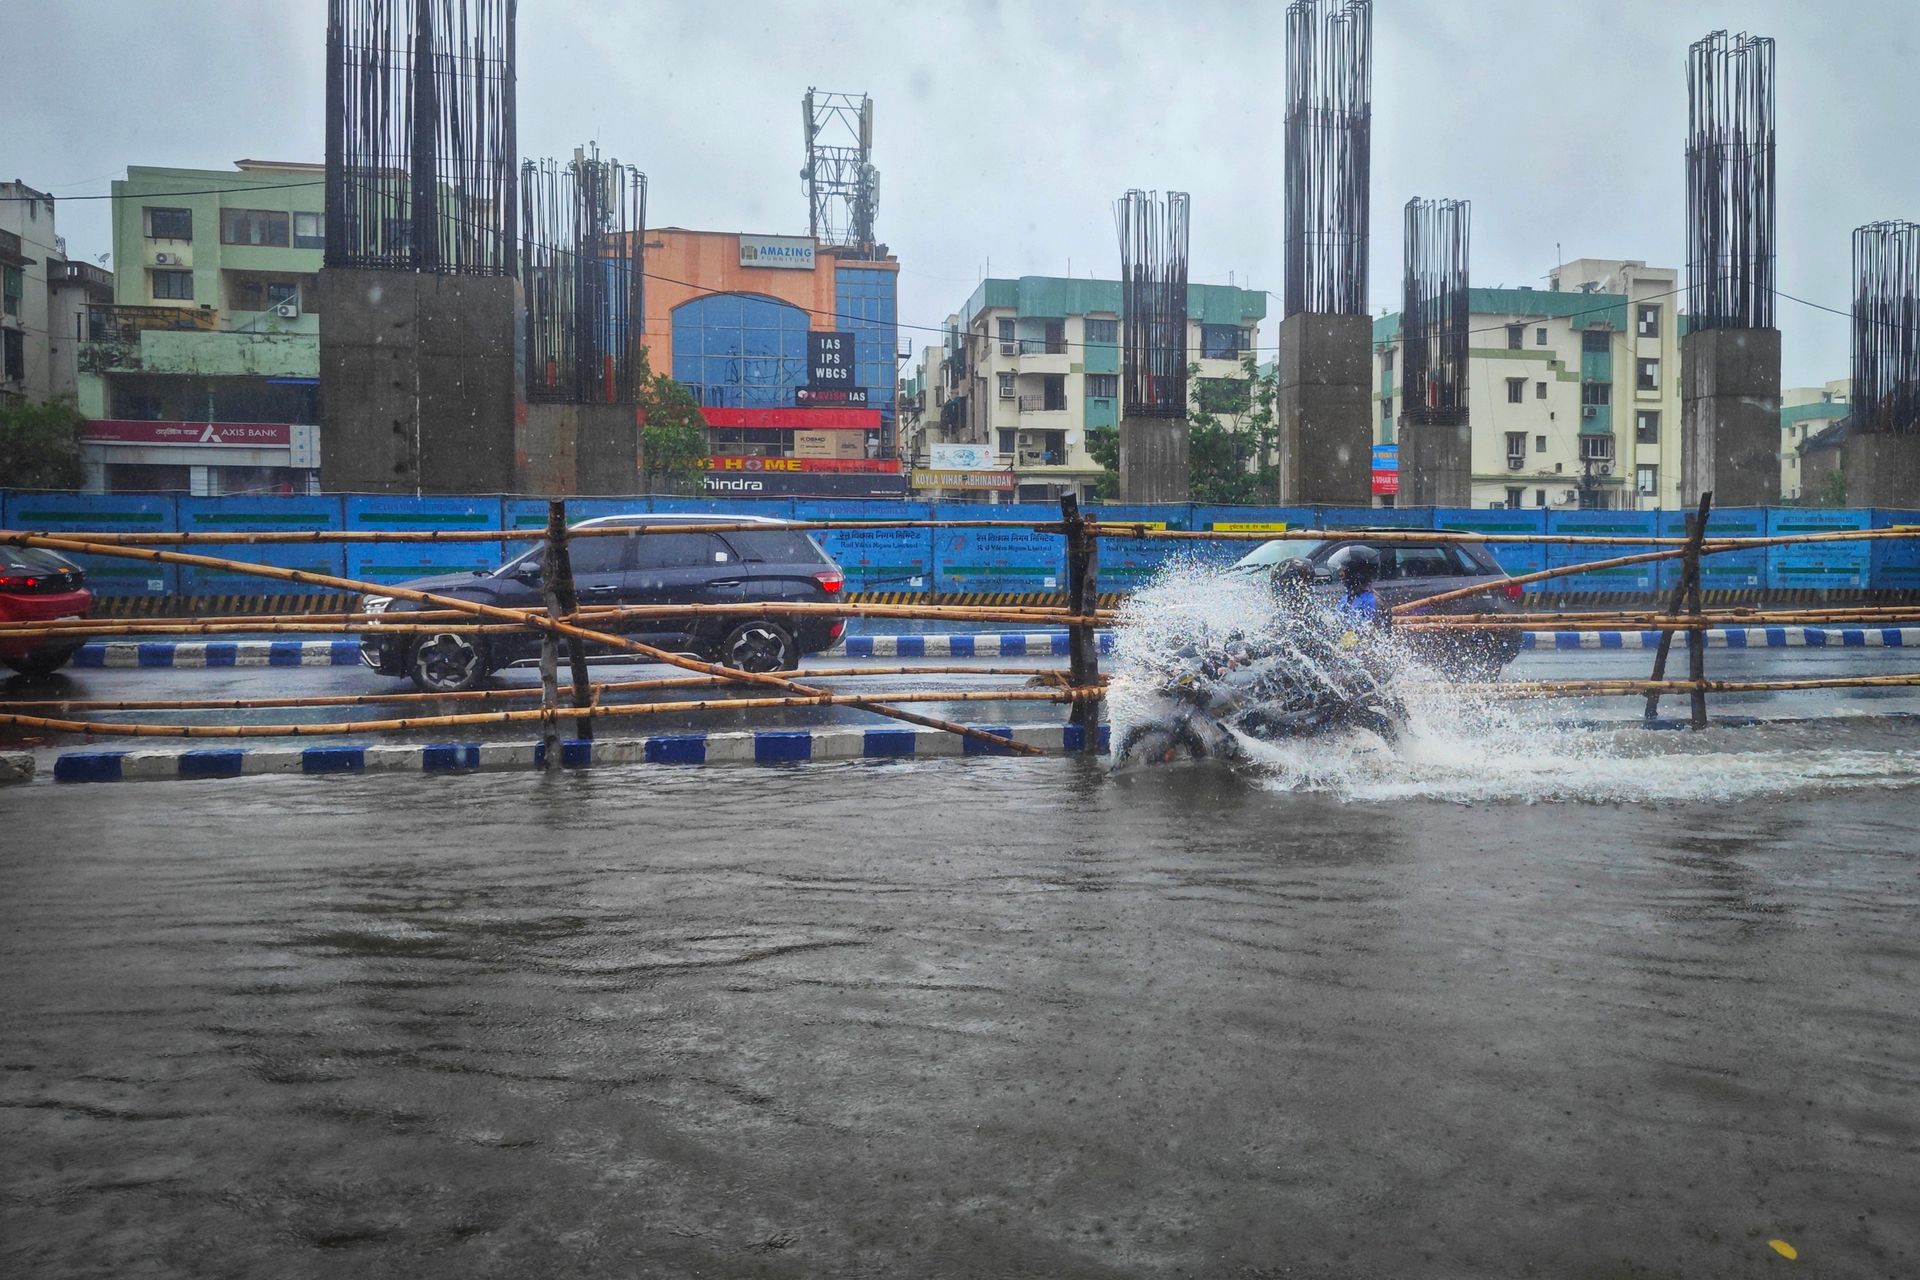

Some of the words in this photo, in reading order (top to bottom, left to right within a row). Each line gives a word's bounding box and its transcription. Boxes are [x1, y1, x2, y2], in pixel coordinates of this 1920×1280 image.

[760, 246, 812, 257] AMAZING
[821, 338, 841, 350] IAS
[821, 353, 841, 364] IPS
[815, 367, 847, 379] WBCS
[849, 392, 866, 401] IAS
[221, 428, 245, 437] AXIS
[248, 429, 277, 437] BANK
[724, 458, 802, 471] HOME
[689, 478, 763, 490] hindra
[915, 474, 938, 485] KOYLA
[965, 475, 1011, 487] ABHINANDAN
